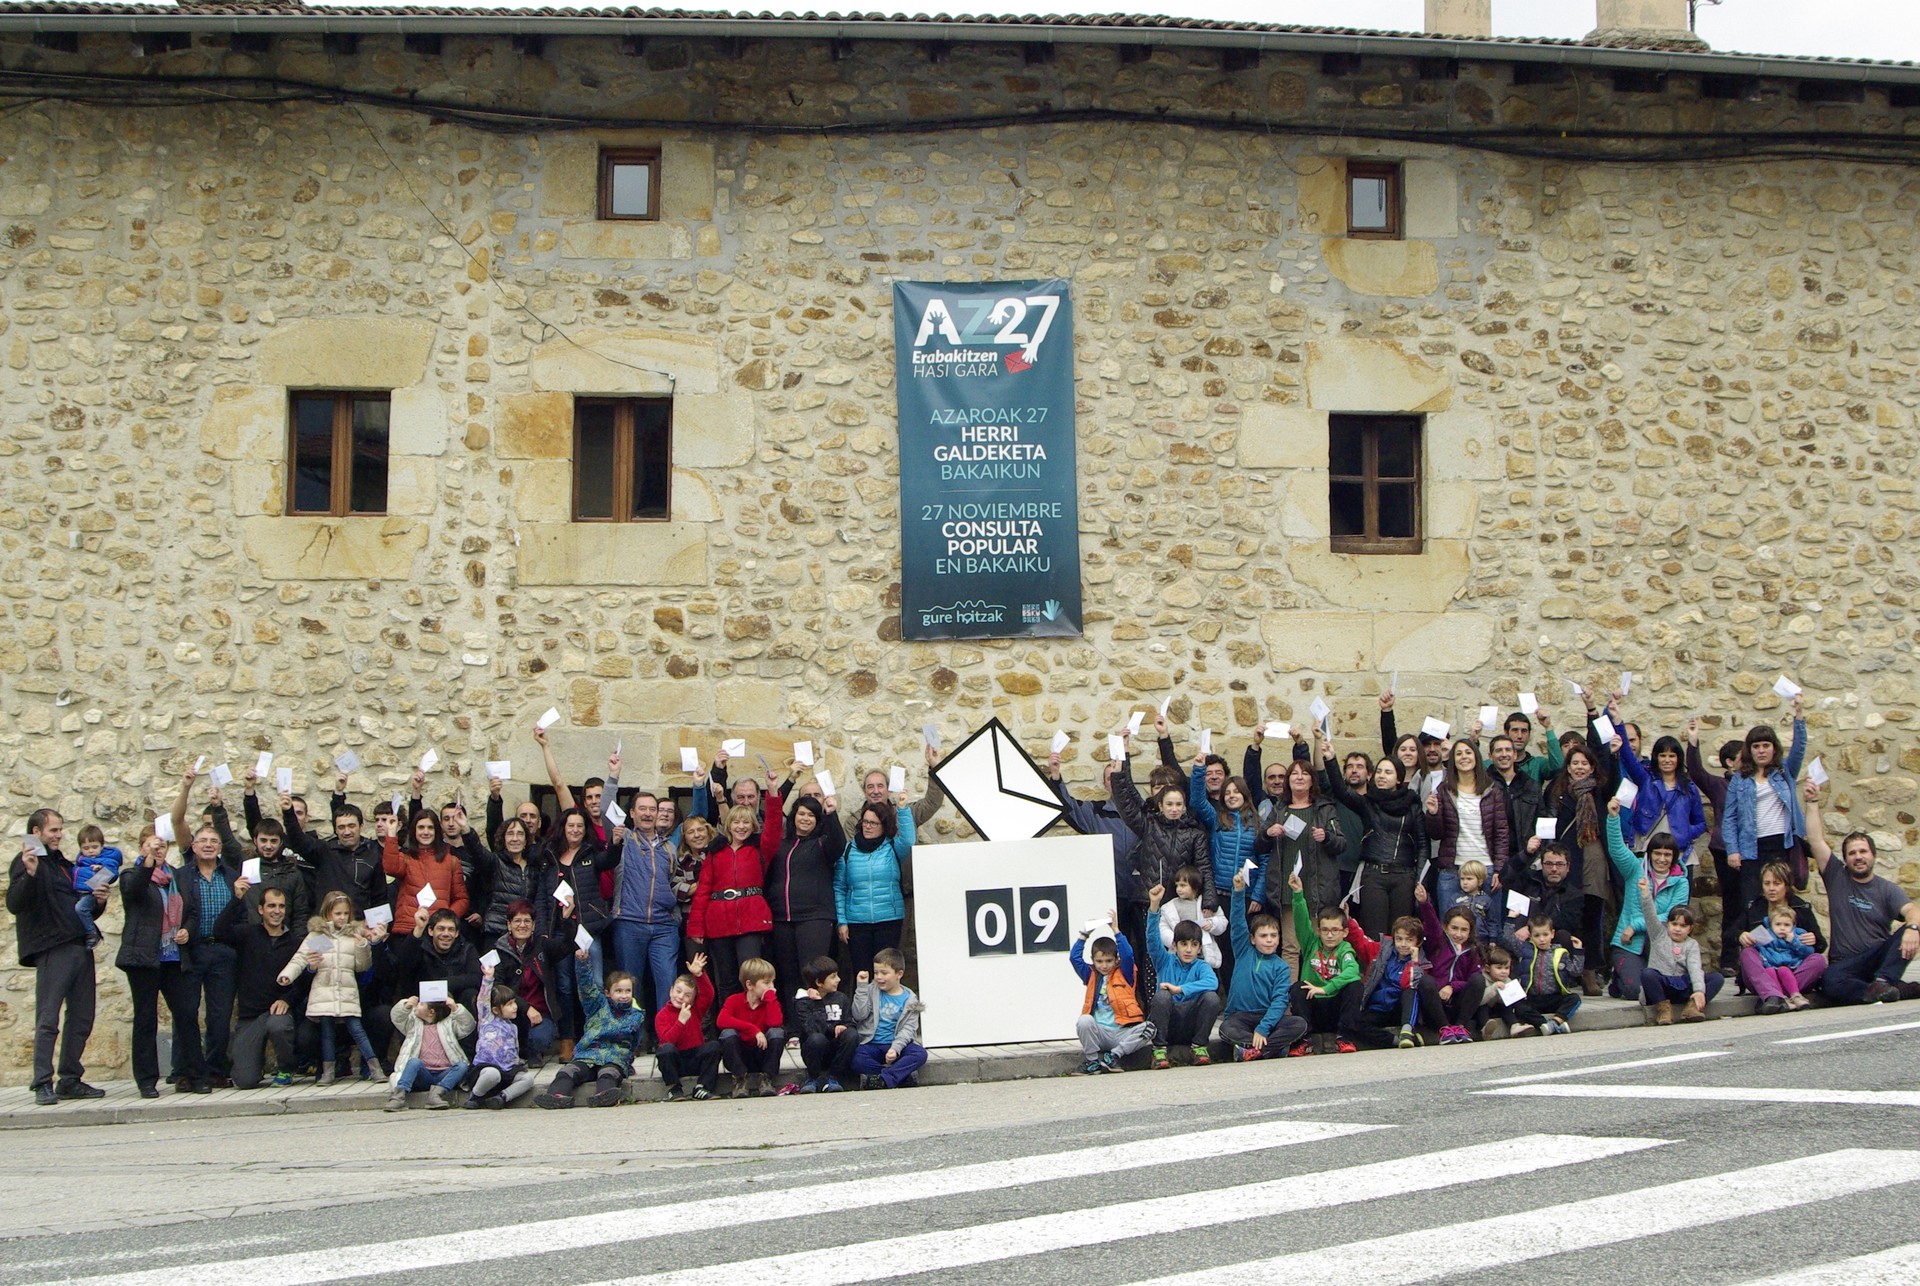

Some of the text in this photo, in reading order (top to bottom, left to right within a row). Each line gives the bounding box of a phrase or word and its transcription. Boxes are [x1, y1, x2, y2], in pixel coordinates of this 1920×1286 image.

[914, 296, 1060, 356] AZ27
[912, 349, 998, 364] Erabakitzen
[913, 363, 998, 378] HASI GARA
[929, 407, 1048, 424] AZAROAK 27
[961, 426, 1019, 442] HERRI
[933, 444, 1047, 462] GALDEKETA
[941, 463, 1041, 480] BAKAIKUN
[921, 502, 1062, 521] 27 NOVIEMBRE
[941, 520, 1043, 538] CONSULTA
[947, 539, 1038, 556] POPULAR
[936, 557, 1051, 574] EN BAKAIKU
[922, 612, 953, 627] gure
